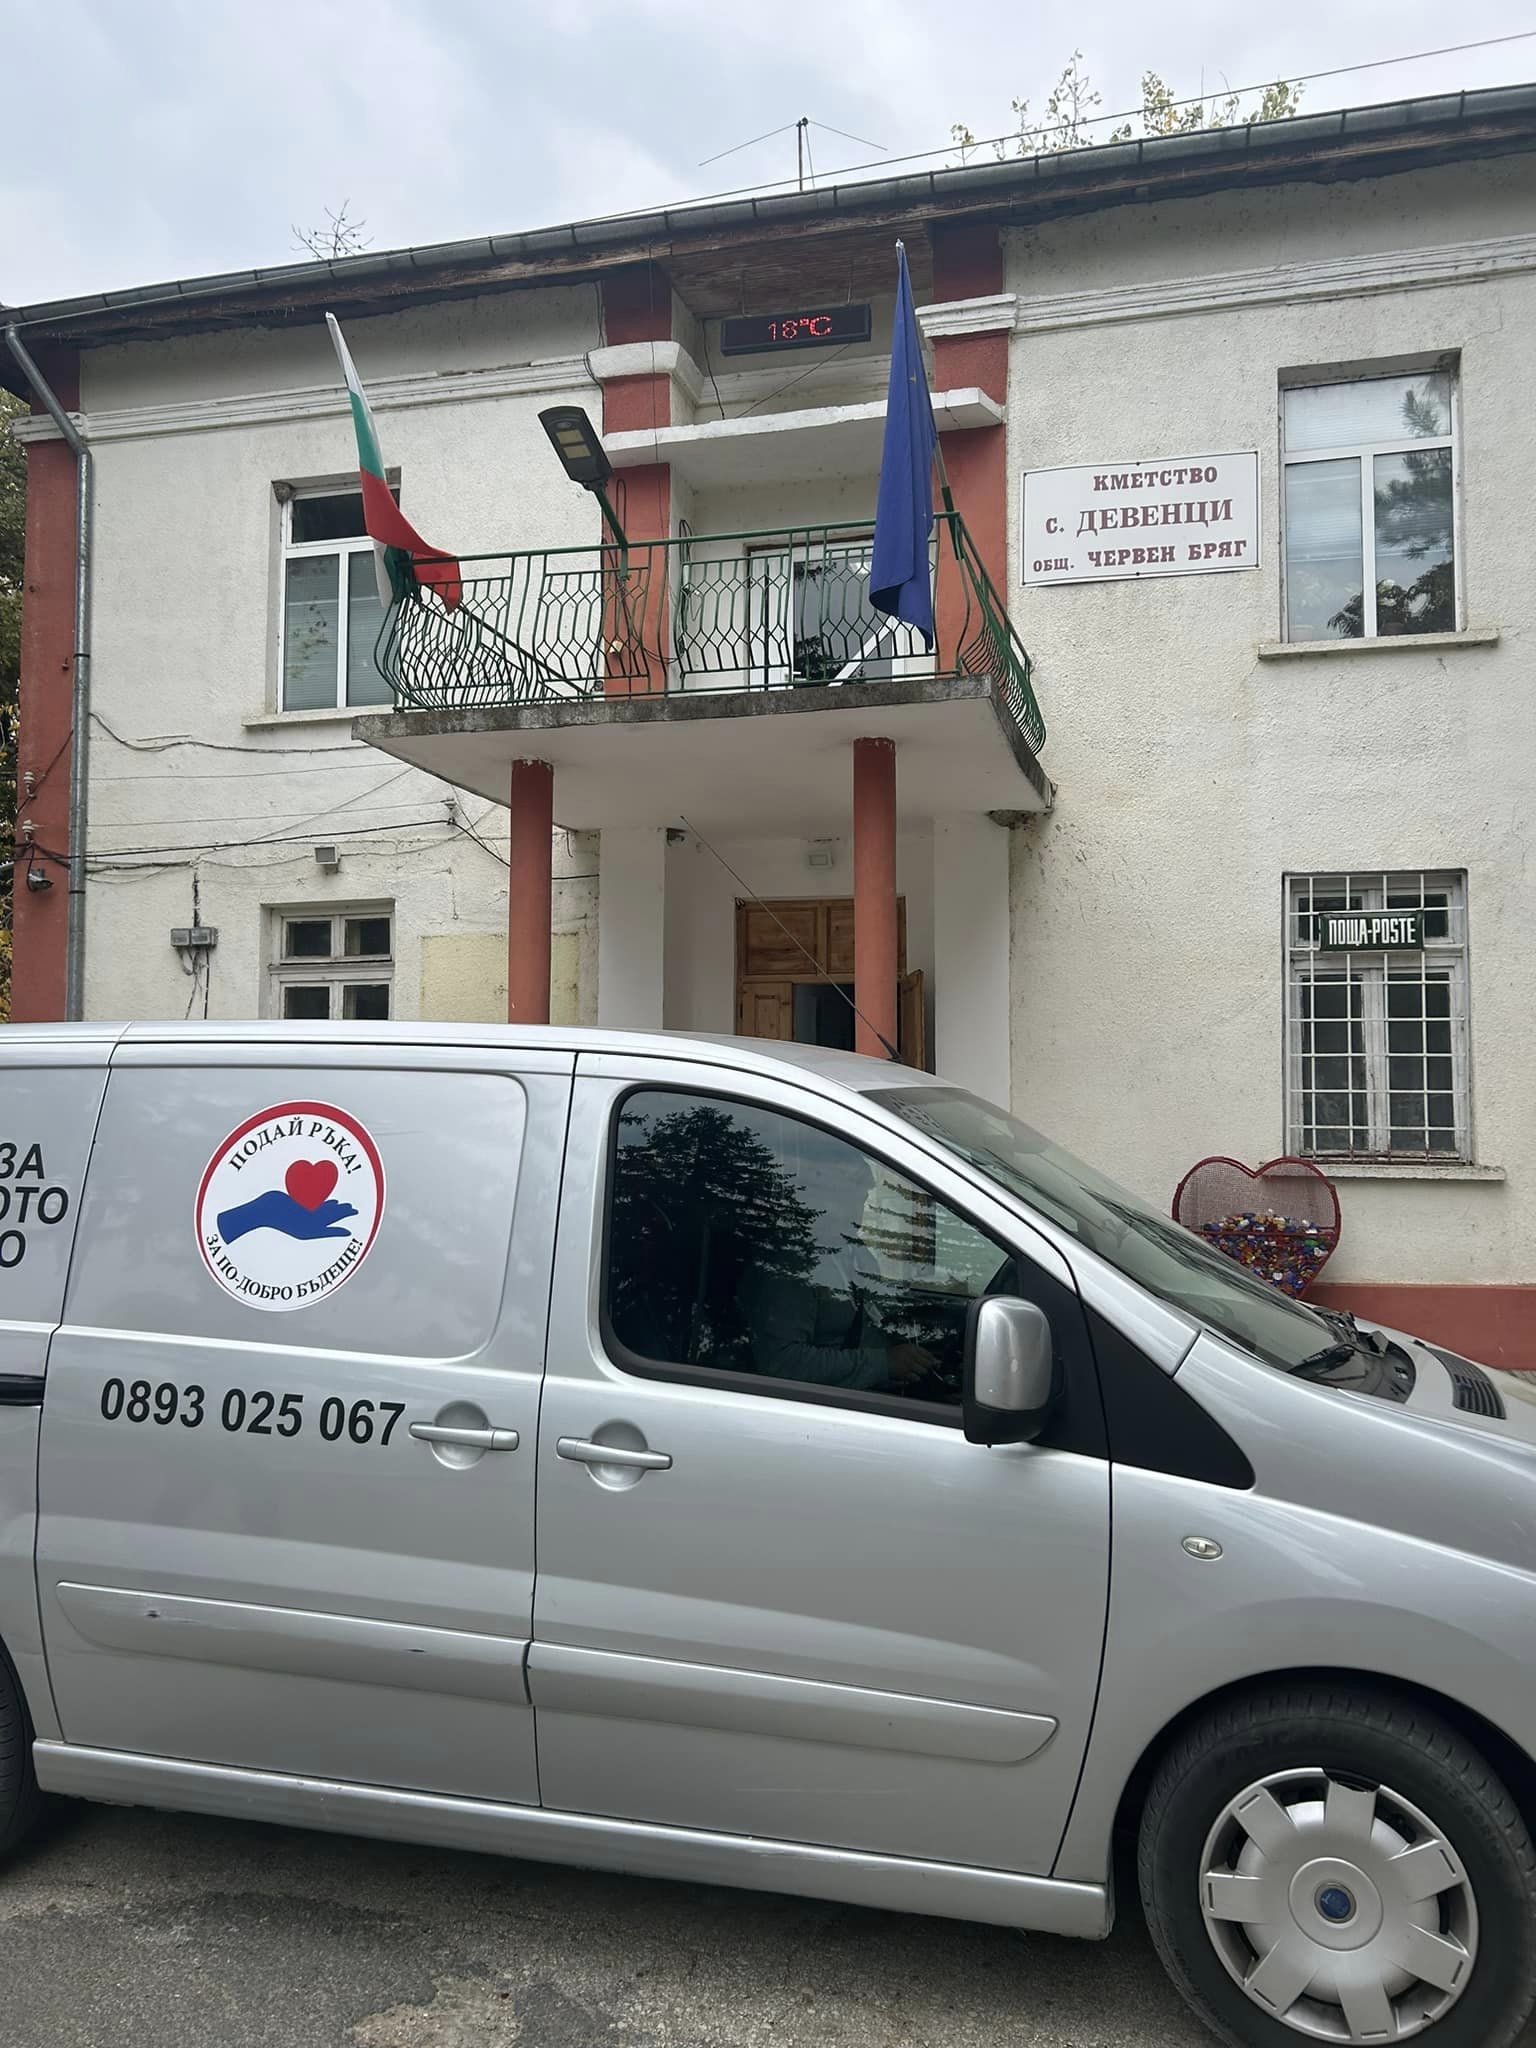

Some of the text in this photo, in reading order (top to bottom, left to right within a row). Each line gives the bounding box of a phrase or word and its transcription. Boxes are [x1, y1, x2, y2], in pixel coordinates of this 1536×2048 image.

[1093, 466, 1218, 491] КМЕТСТВО
[1076, 498, 1233, 537] ДЕВЕНЦИ
[1033, 539, 1247, 572] ОБЩ. ЧЕРВЕН БРЯГ
[228, 1116, 362, 1175] ПОДАЙ РЪКА!
[206, 1233, 363, 1301] ЗА ПО-ДОБРО БЪДЕЩЕ!
[100, 1377, 406, 1446] 0893 025 067
